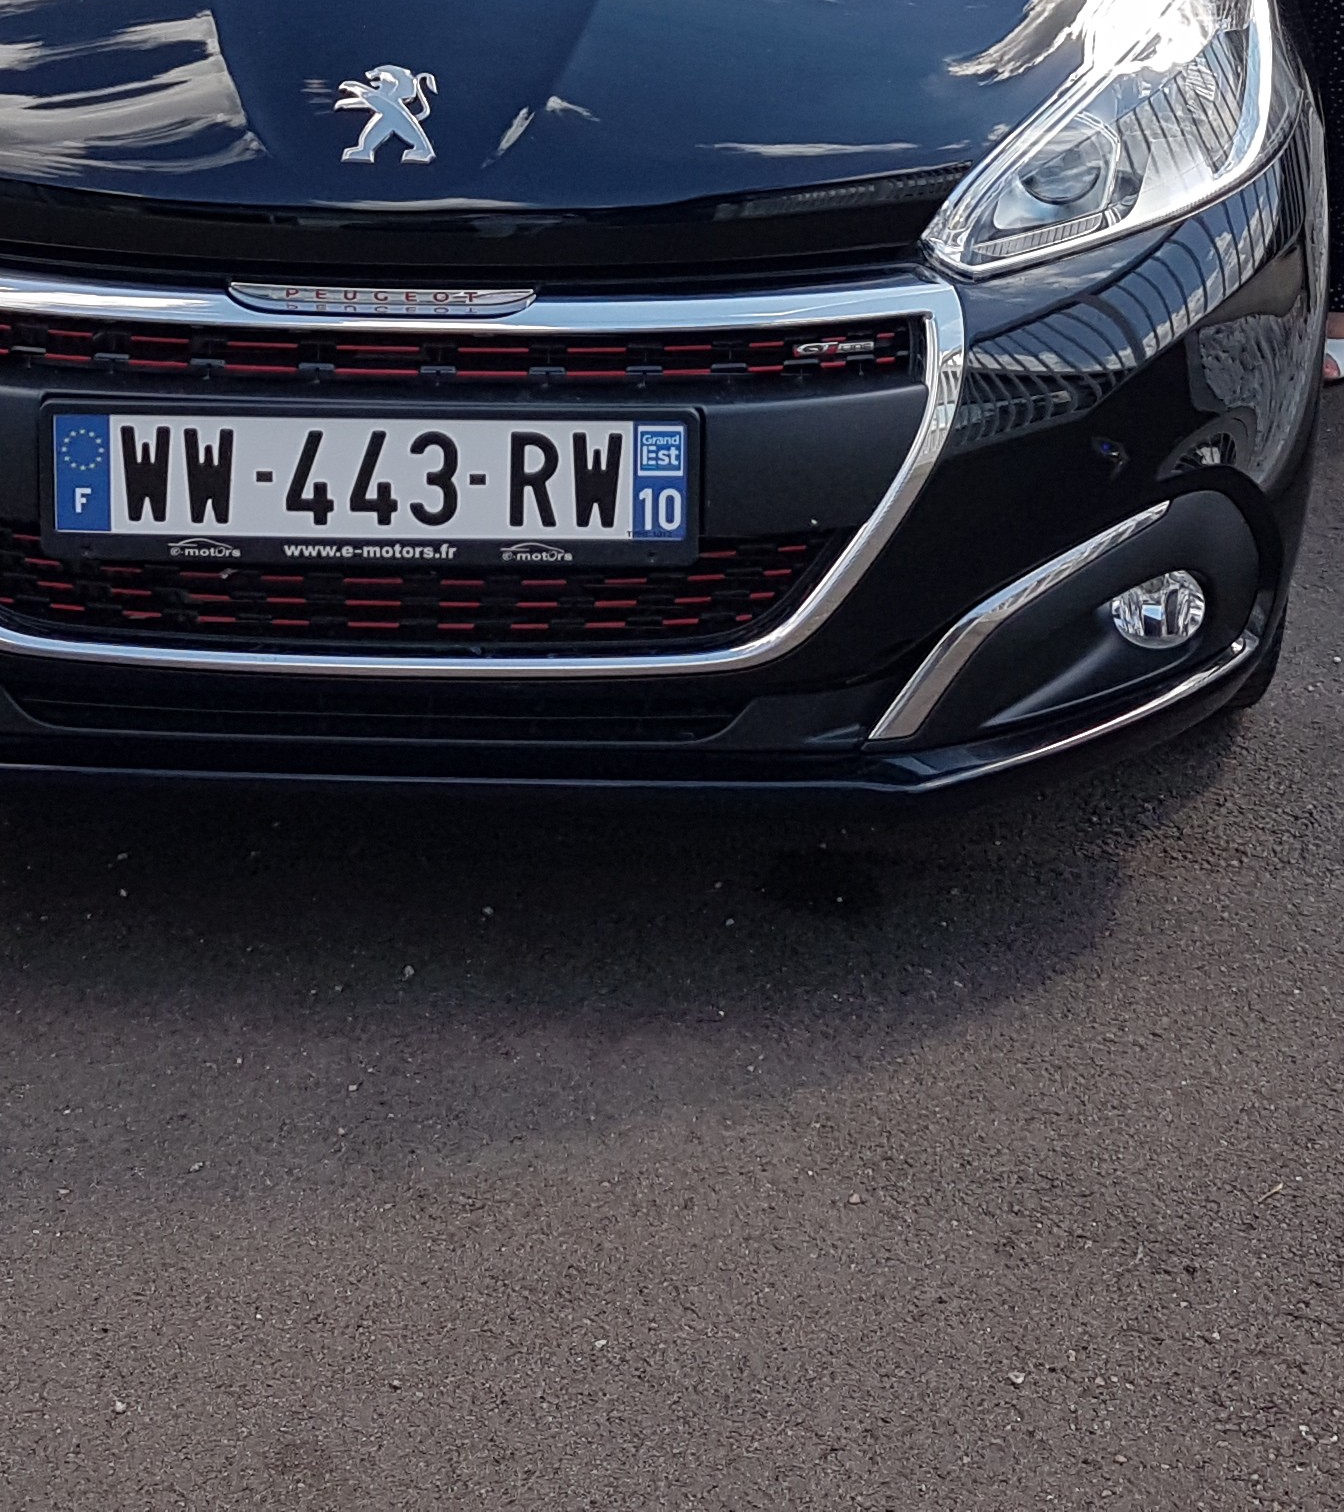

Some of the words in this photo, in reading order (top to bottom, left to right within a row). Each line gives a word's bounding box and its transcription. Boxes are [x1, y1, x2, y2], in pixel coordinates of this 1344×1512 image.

[285, 288, 478, 303] PEUGEOT
[642, 434, 680, 445] Grand
[642, 446, 680, 465] Est
[120, 426, 622, 527] WW-443-RW
[74, 487, 92, 514] F
[638, 488, 682, 531] 10
[283, 543, 457, 560] www.e-motors.fr
